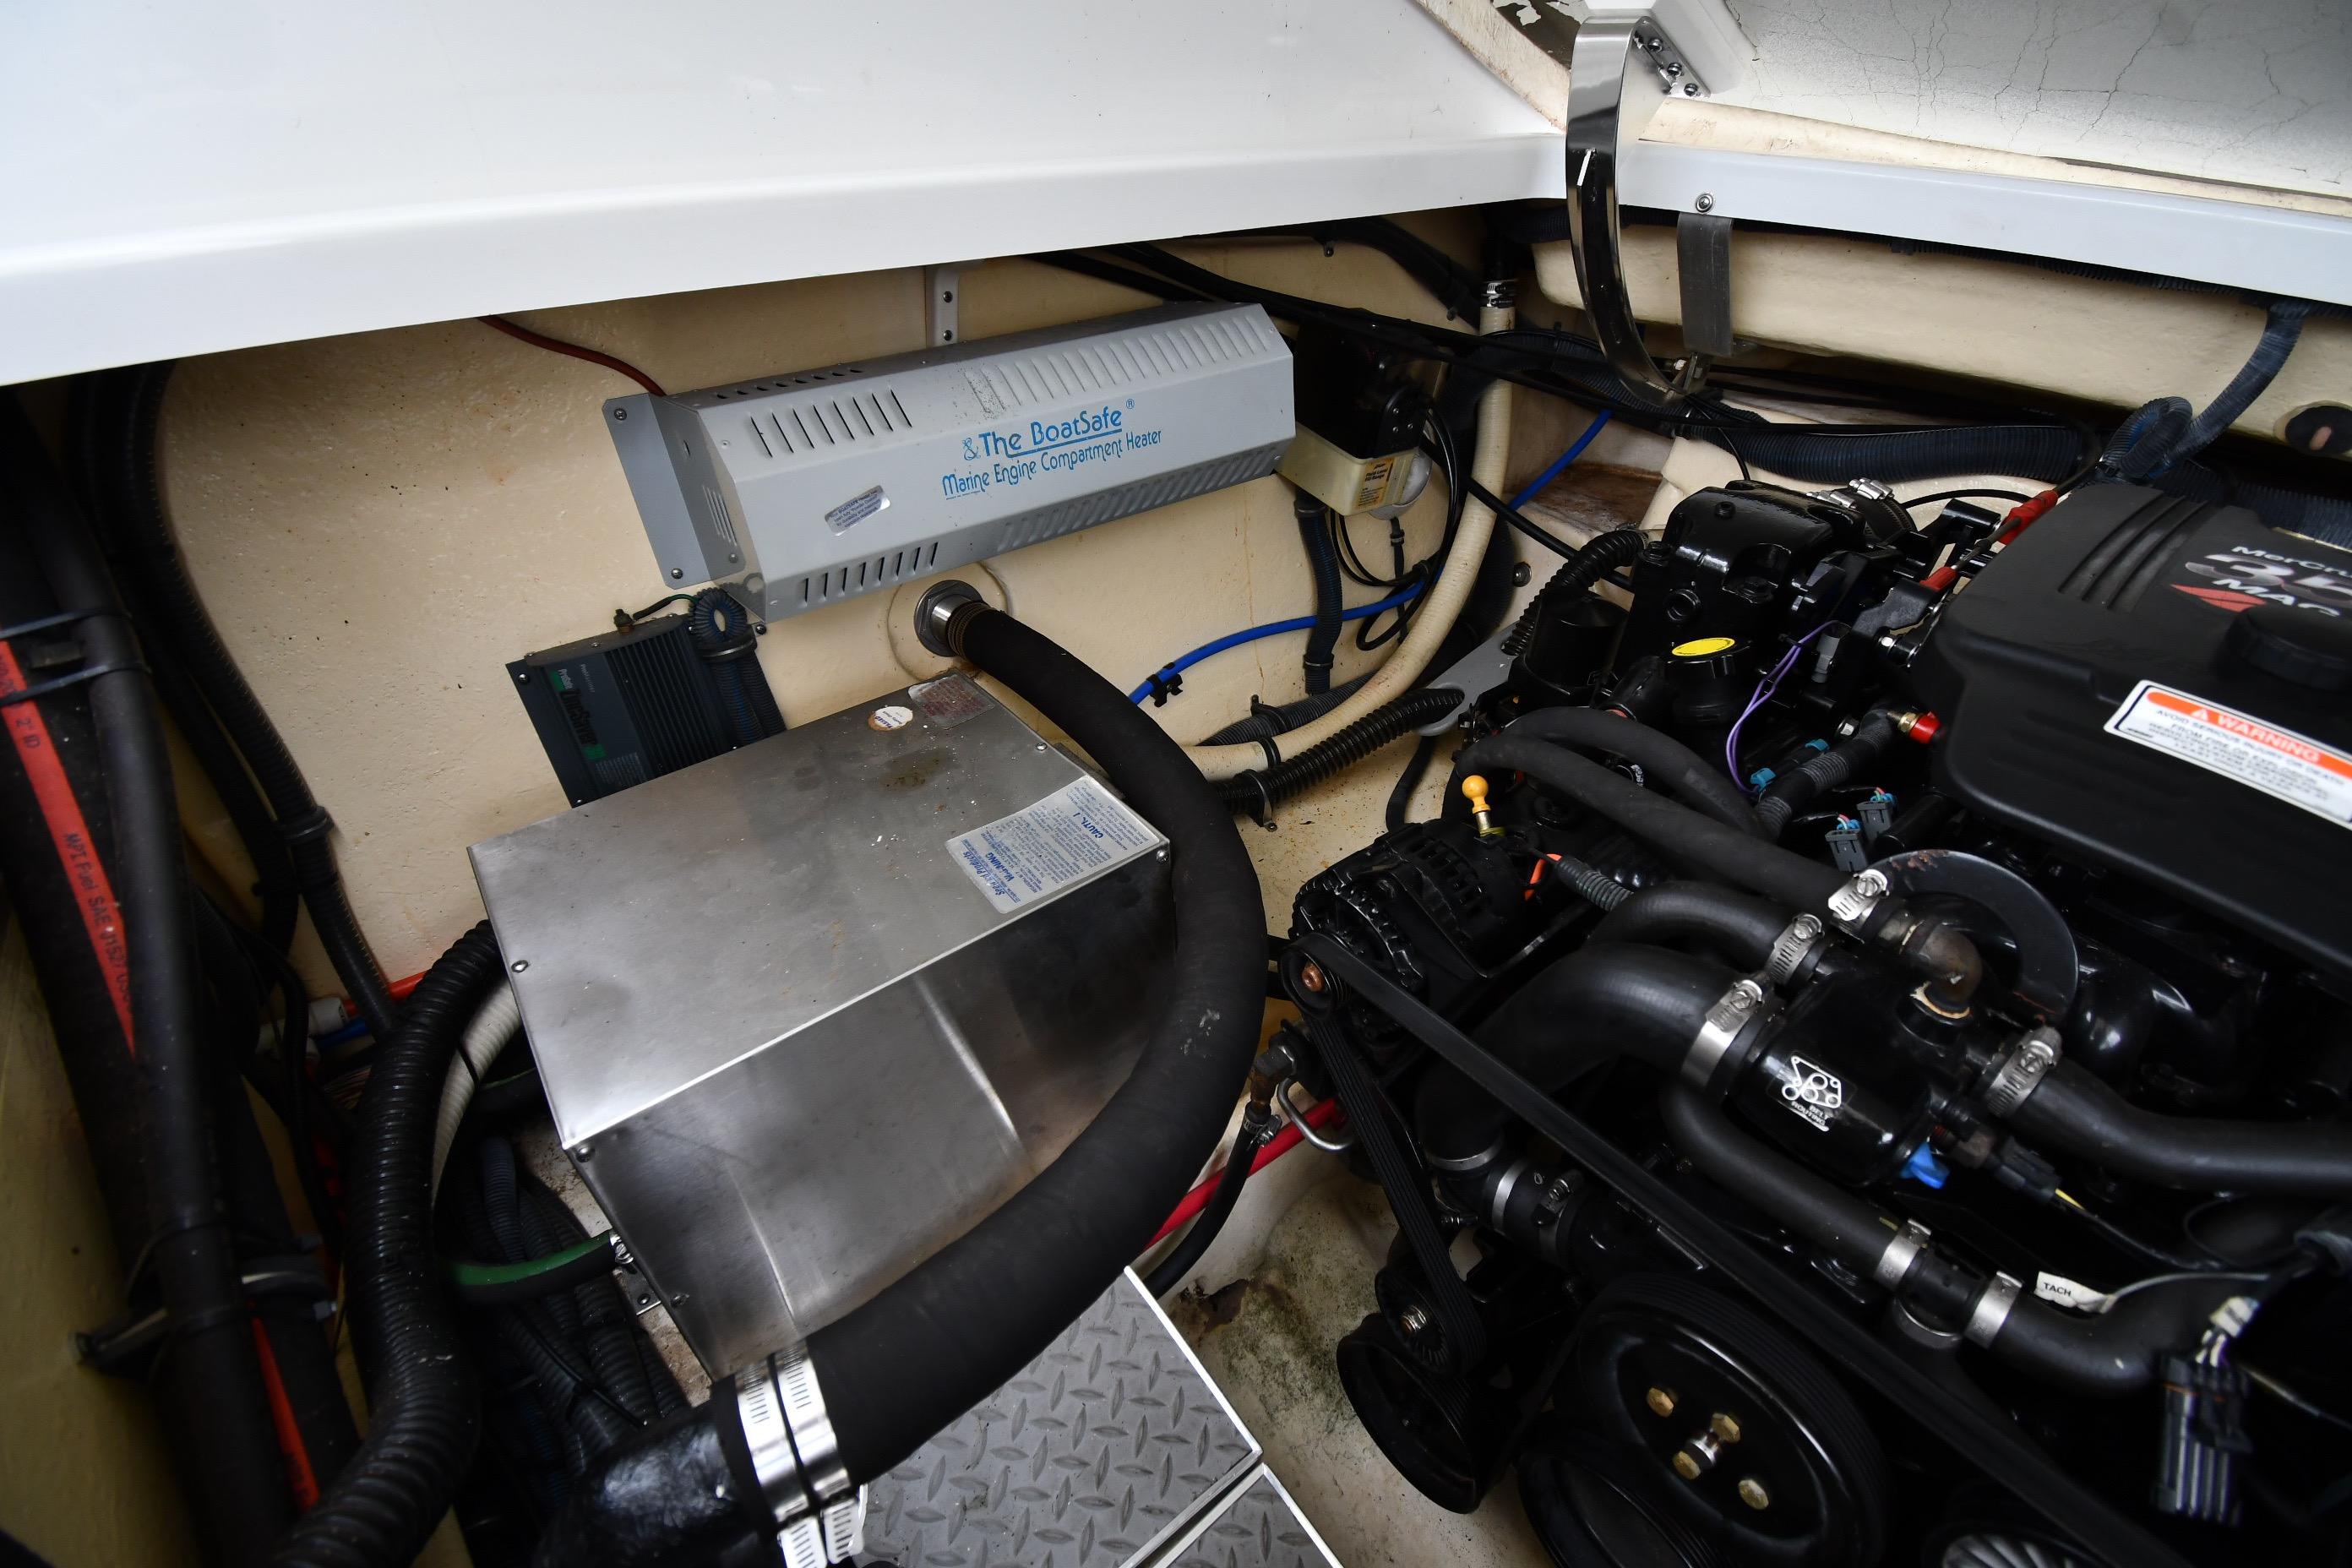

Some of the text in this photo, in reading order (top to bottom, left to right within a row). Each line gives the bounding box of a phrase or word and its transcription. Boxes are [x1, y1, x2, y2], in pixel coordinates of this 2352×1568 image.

[978, 432, 1022, 458] The
[942, 429, 1162, 496] Marine Engine Compartment Heater
[2217, 714, 2320, 763] WARNING
[88, 896, 112, 926] SAE
[1792, 1101, 1826, 1125] ROUTING
[1810, 1105, 1828, 1120] BELT
[2044, 1282, 2072, 1297] TACH
